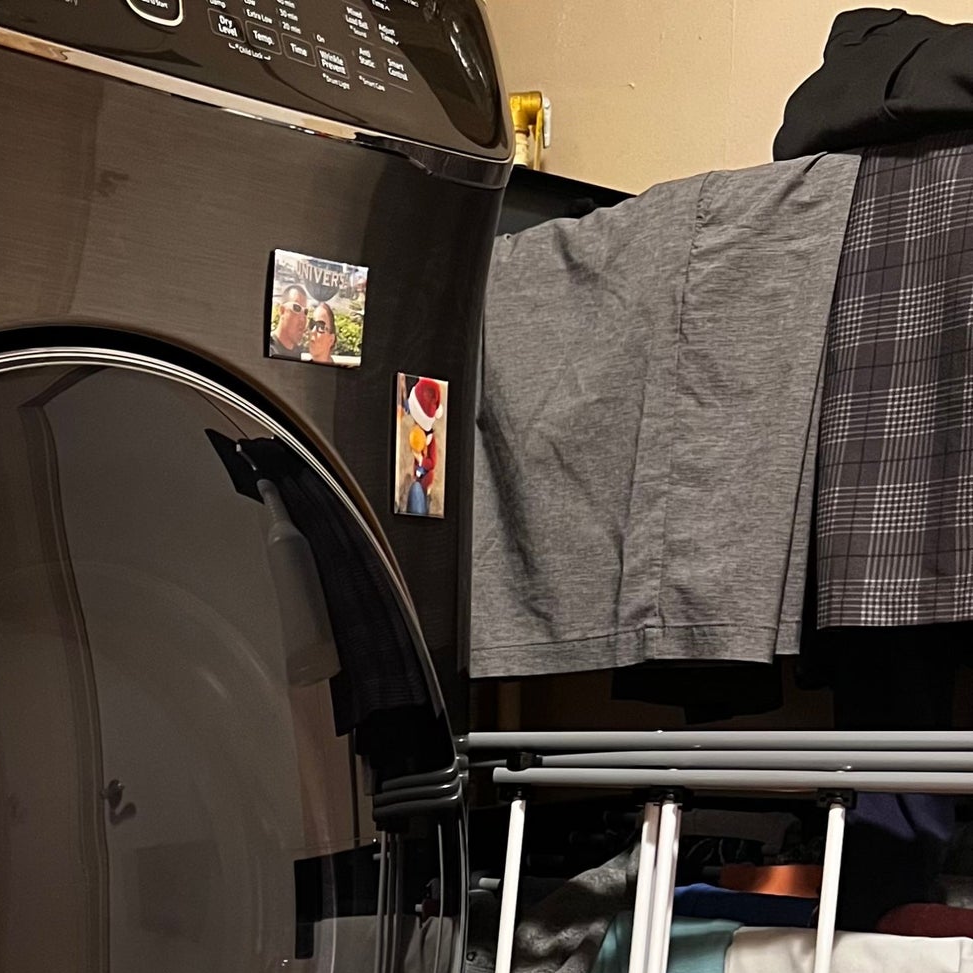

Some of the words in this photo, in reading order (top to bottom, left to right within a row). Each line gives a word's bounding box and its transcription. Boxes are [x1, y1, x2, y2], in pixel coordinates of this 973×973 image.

[219, 15, 232, 28] Dry
[246, 9, 261, 20] Extra
[261, 14, 272, 24] Low
[287, 13, 298, 21] min
[218, 23, 238, 37] Level
[290, 26, 301, 34] min
[253, 30, 274, 45] Temp.
[317, 34, 325, 43] On
[290, 43, 307, 56] Time
[319, 50, 344, 66] Wrinkle
[321, 59, 346, 74] Prevent
[296, 260, 348, 289] UNIVERS
